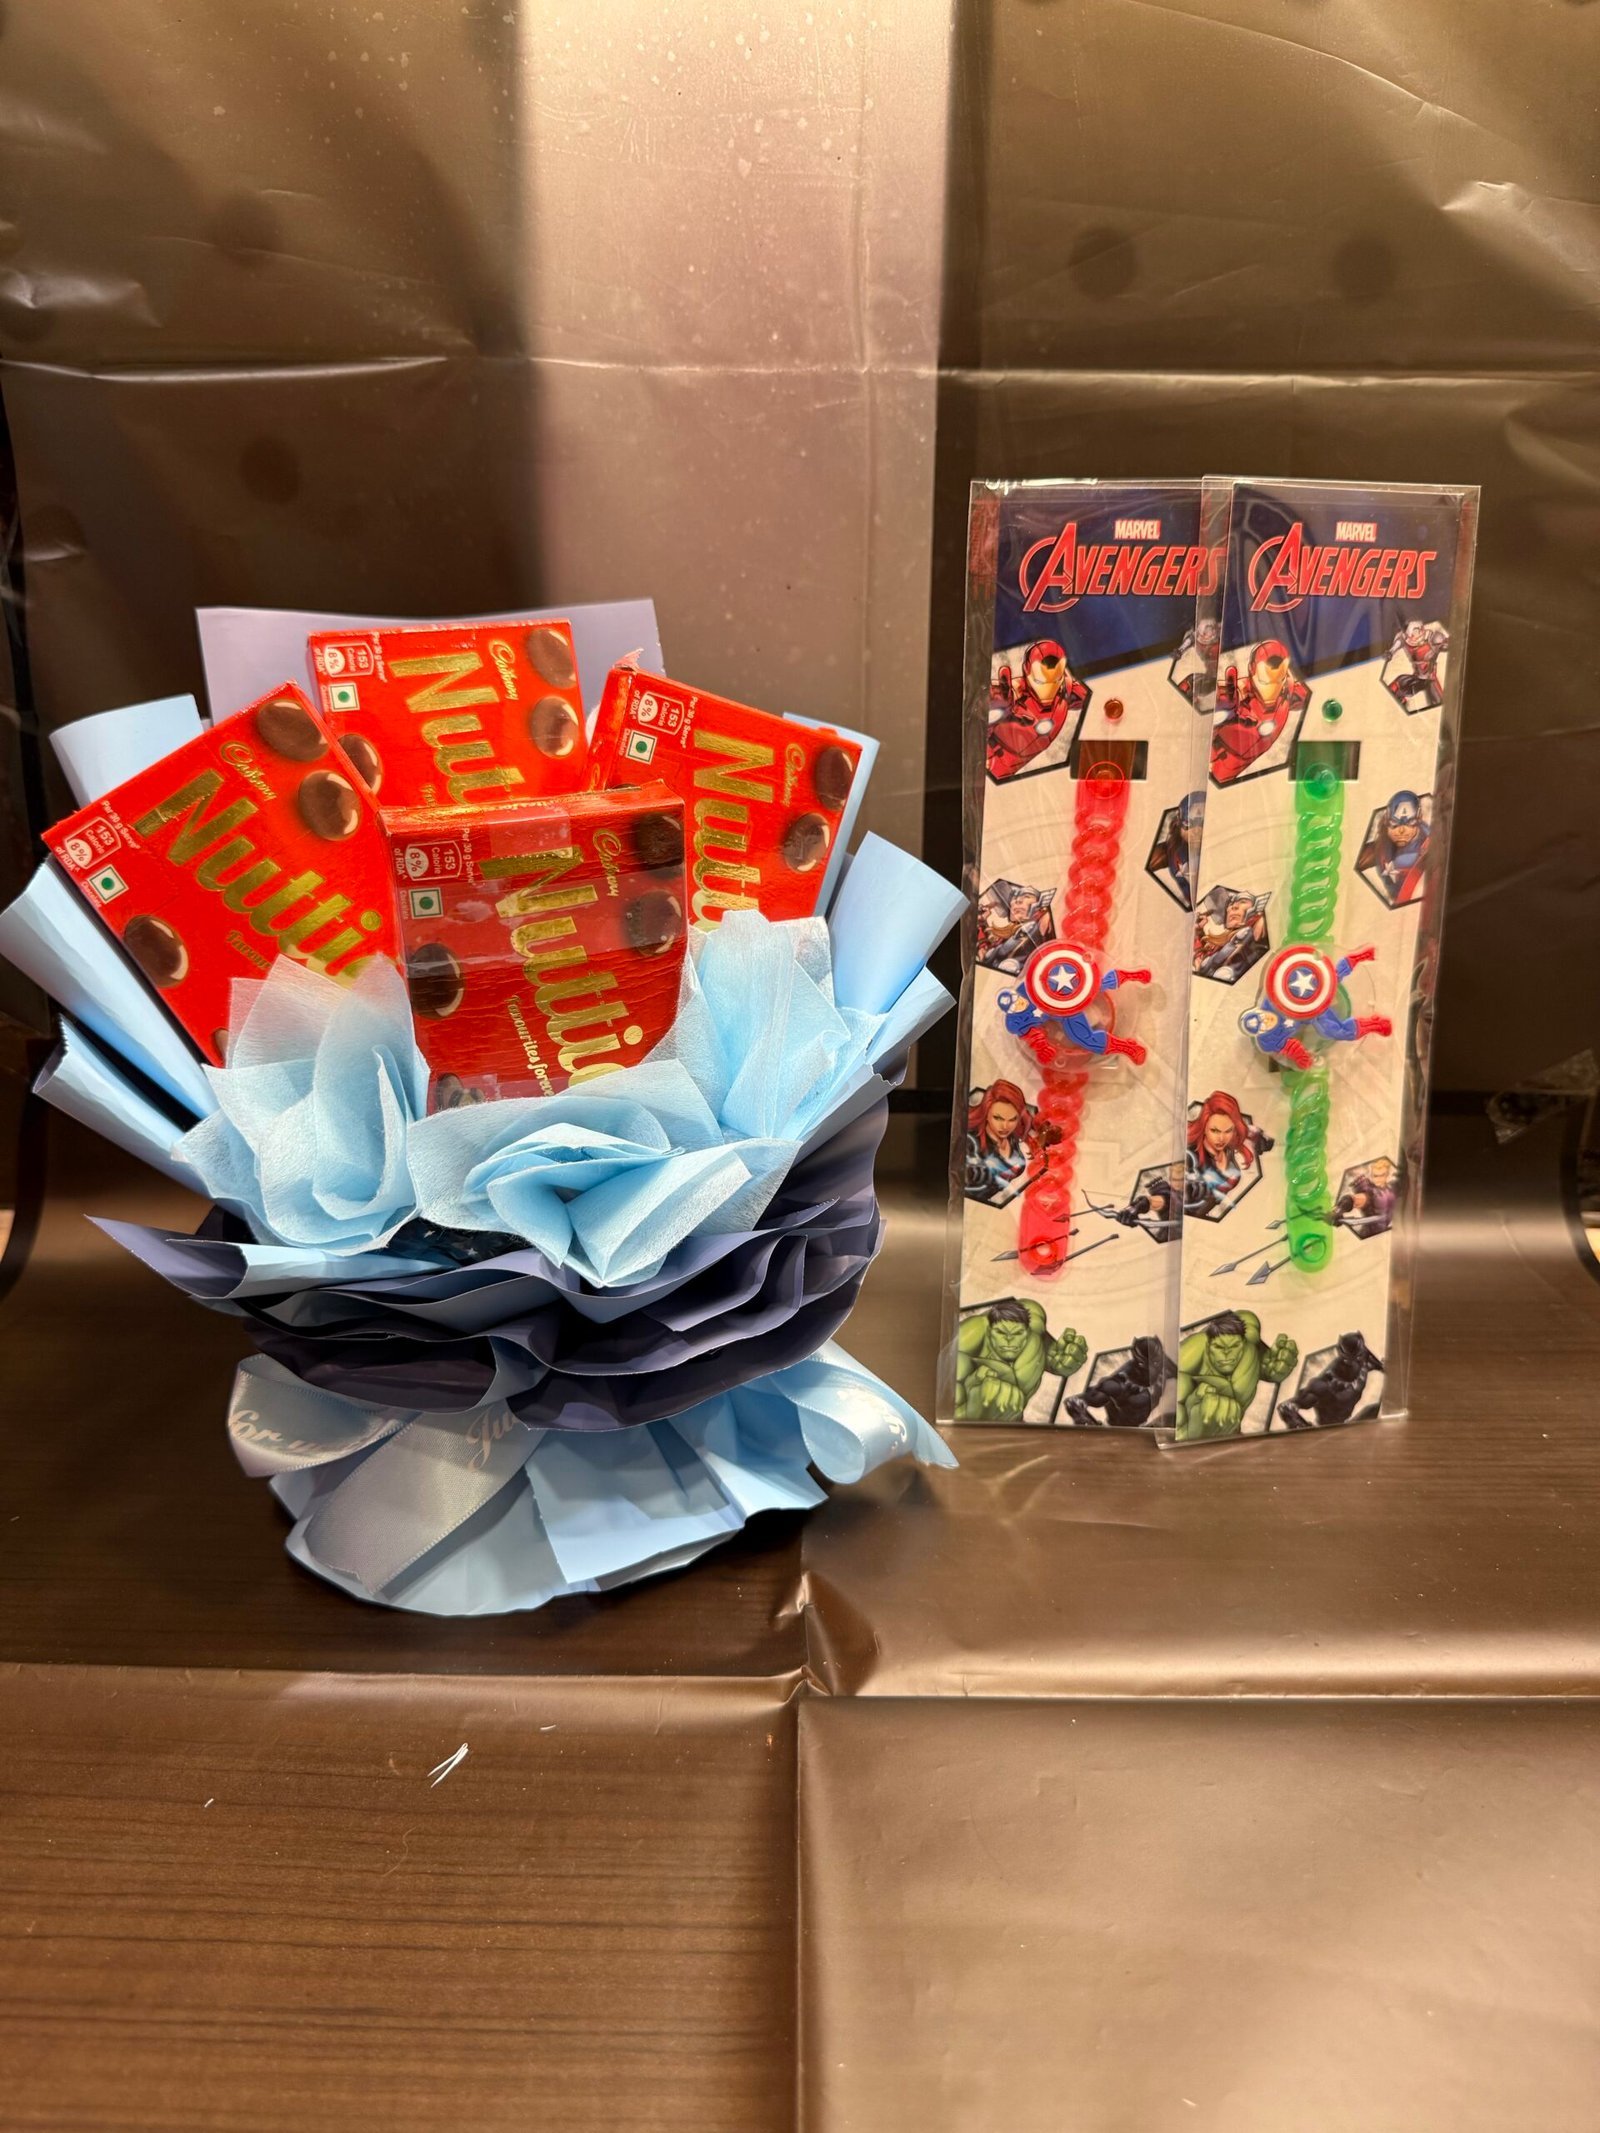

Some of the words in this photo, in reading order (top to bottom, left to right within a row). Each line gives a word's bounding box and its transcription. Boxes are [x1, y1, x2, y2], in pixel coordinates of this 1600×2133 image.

[1114, 519, 1161, 540] MARVEL
[1335, 521, 1377, 542] MARVEL
[1019, 522, 1229, 613] AVENGERS
[1248, 522, 1437, 612] AVENGERS
[357, 649, 369, 669] 153
[641, 699, 654, 717] 8%
[689, 696, 698, 709] Per
[657, 701, 670, 727] Calorie
[667, 708, 680, 728] 153
[687, 709, 696, 719] 30
[388, 652, 526, 807] Nut
[219, 740, 277, 801] Cadbury
[102, 800, 114, 814] Per
[109, 812, 121, 823] 30
[85, 829, 105, 854] Calorie
[96, 825, 115, 846] 153
[462, 828, 470, 841] Per
[691, 729, 775, 935] Nutt
[55, 846, 66, 856] of
[70, 842, 88, 862] 8%
[394, 848, 403, 858] of
[463, 842, 472, 853] 30
[410, 852, 422, 872] 8%
[431, 846, 442, 874] Calorie
[444, 848, 456, 871] 153
[592, 828, 622, 897] Cadbury
[527, 1063, 555, 1097] foreve
